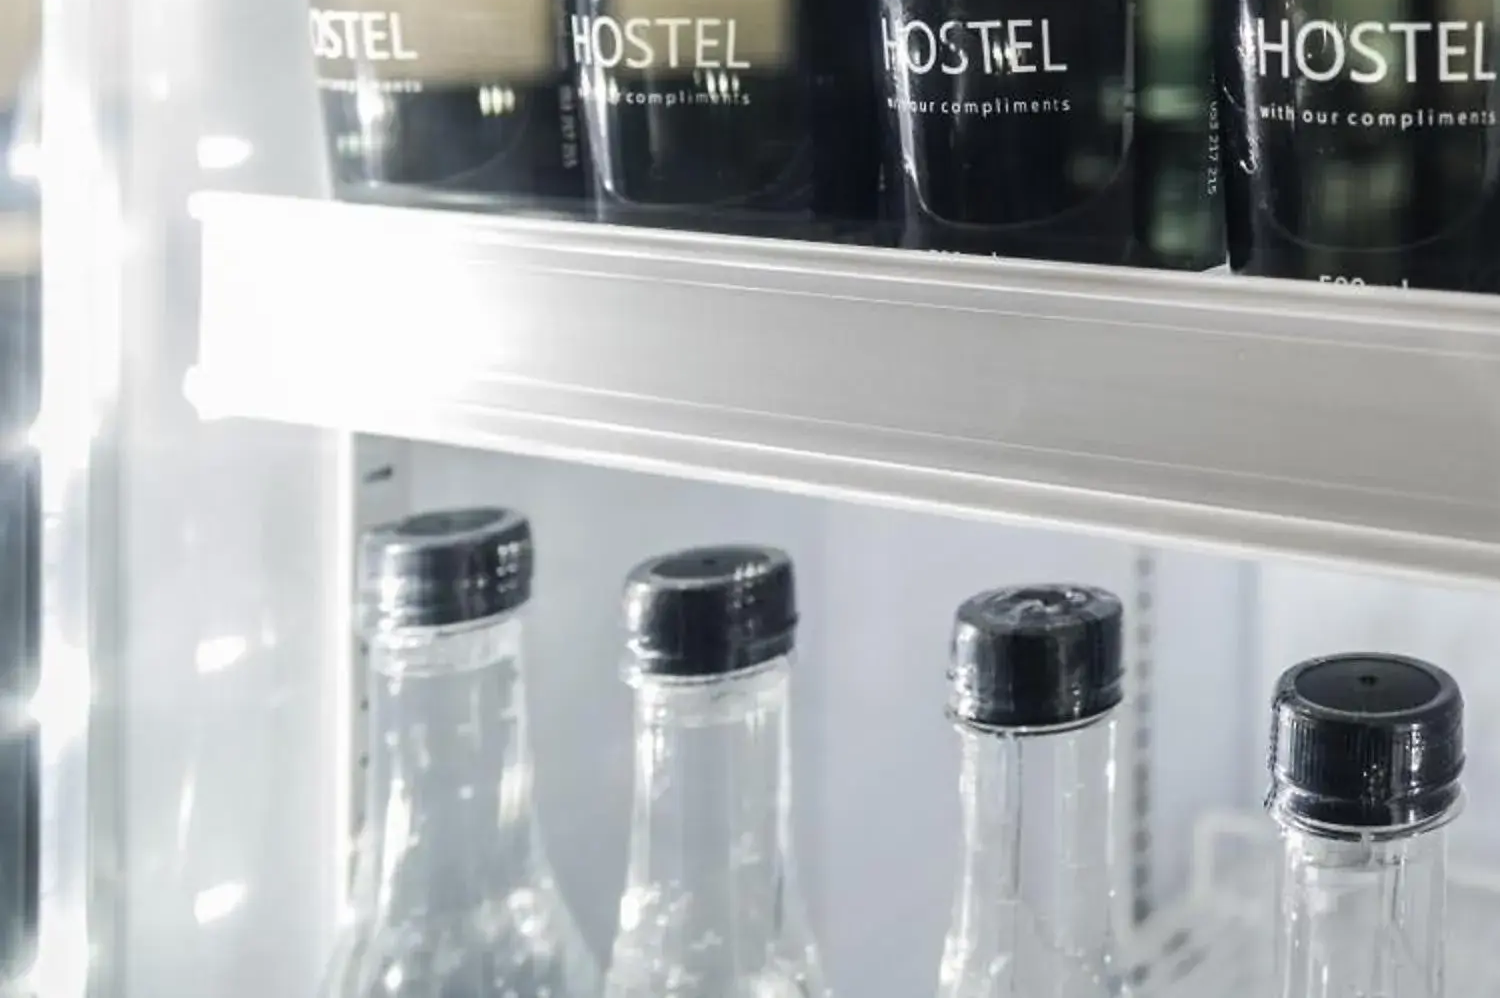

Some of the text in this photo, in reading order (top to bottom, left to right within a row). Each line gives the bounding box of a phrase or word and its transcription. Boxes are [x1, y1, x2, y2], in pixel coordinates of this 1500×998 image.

[309, 8, 418, 60] OSTEL
[571, 14, 751, 69] HOSTEL
[881, 17, 1068, 75] HOSTEL
[1257, 18, 1497, 83] HOSTEL
[941, 97, 1071, 118] compliments
[1259, 104, 1497, 130] with our compliments
